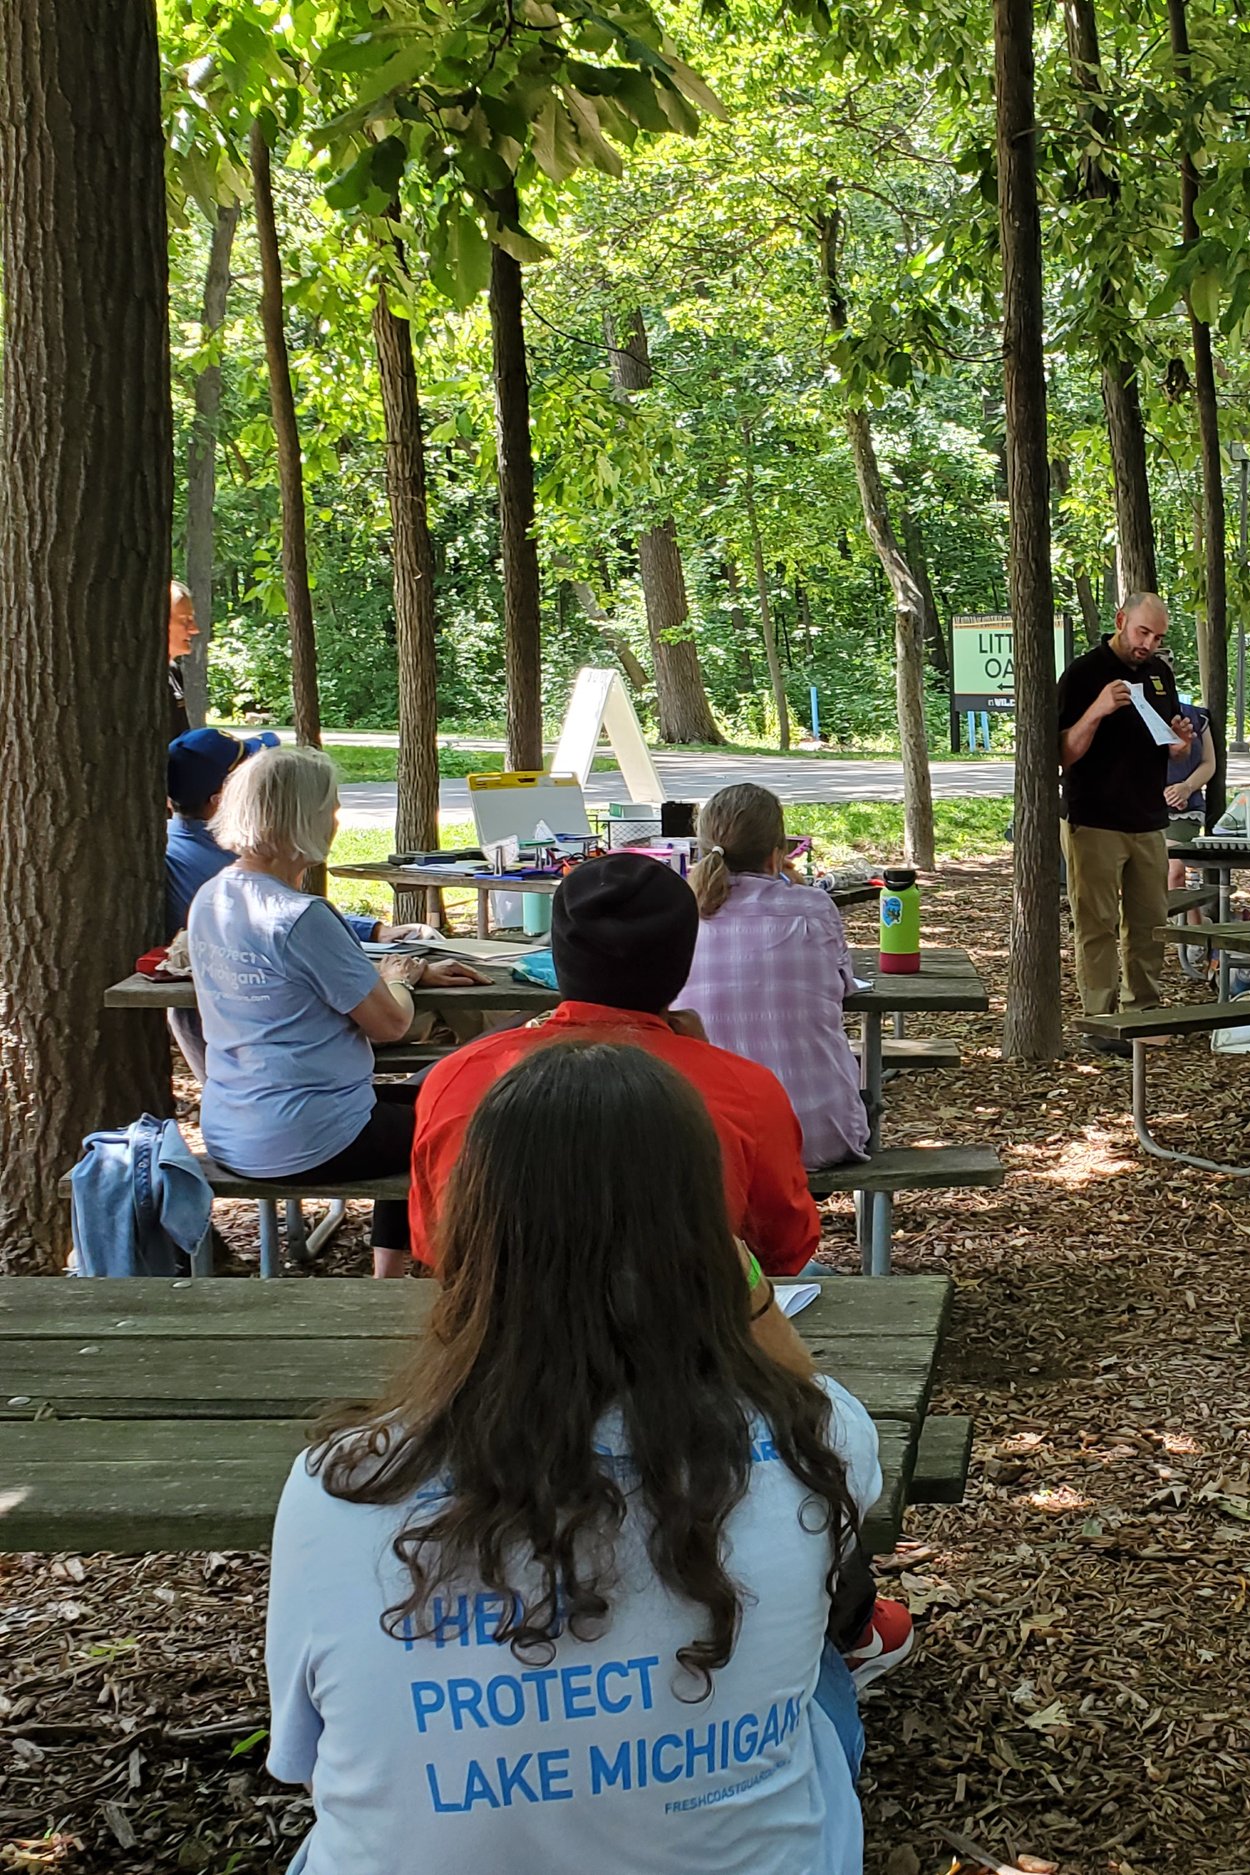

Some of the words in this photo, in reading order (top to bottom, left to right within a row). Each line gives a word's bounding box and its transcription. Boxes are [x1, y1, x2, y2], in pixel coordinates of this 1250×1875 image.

[979, 633, 1014, 654] LITT
[411, 1655, 660, 1733] PROTECT
[426, 1748, 573, 1813] LAKE
[590, 1690, 804, 1795] MICHIGAN
